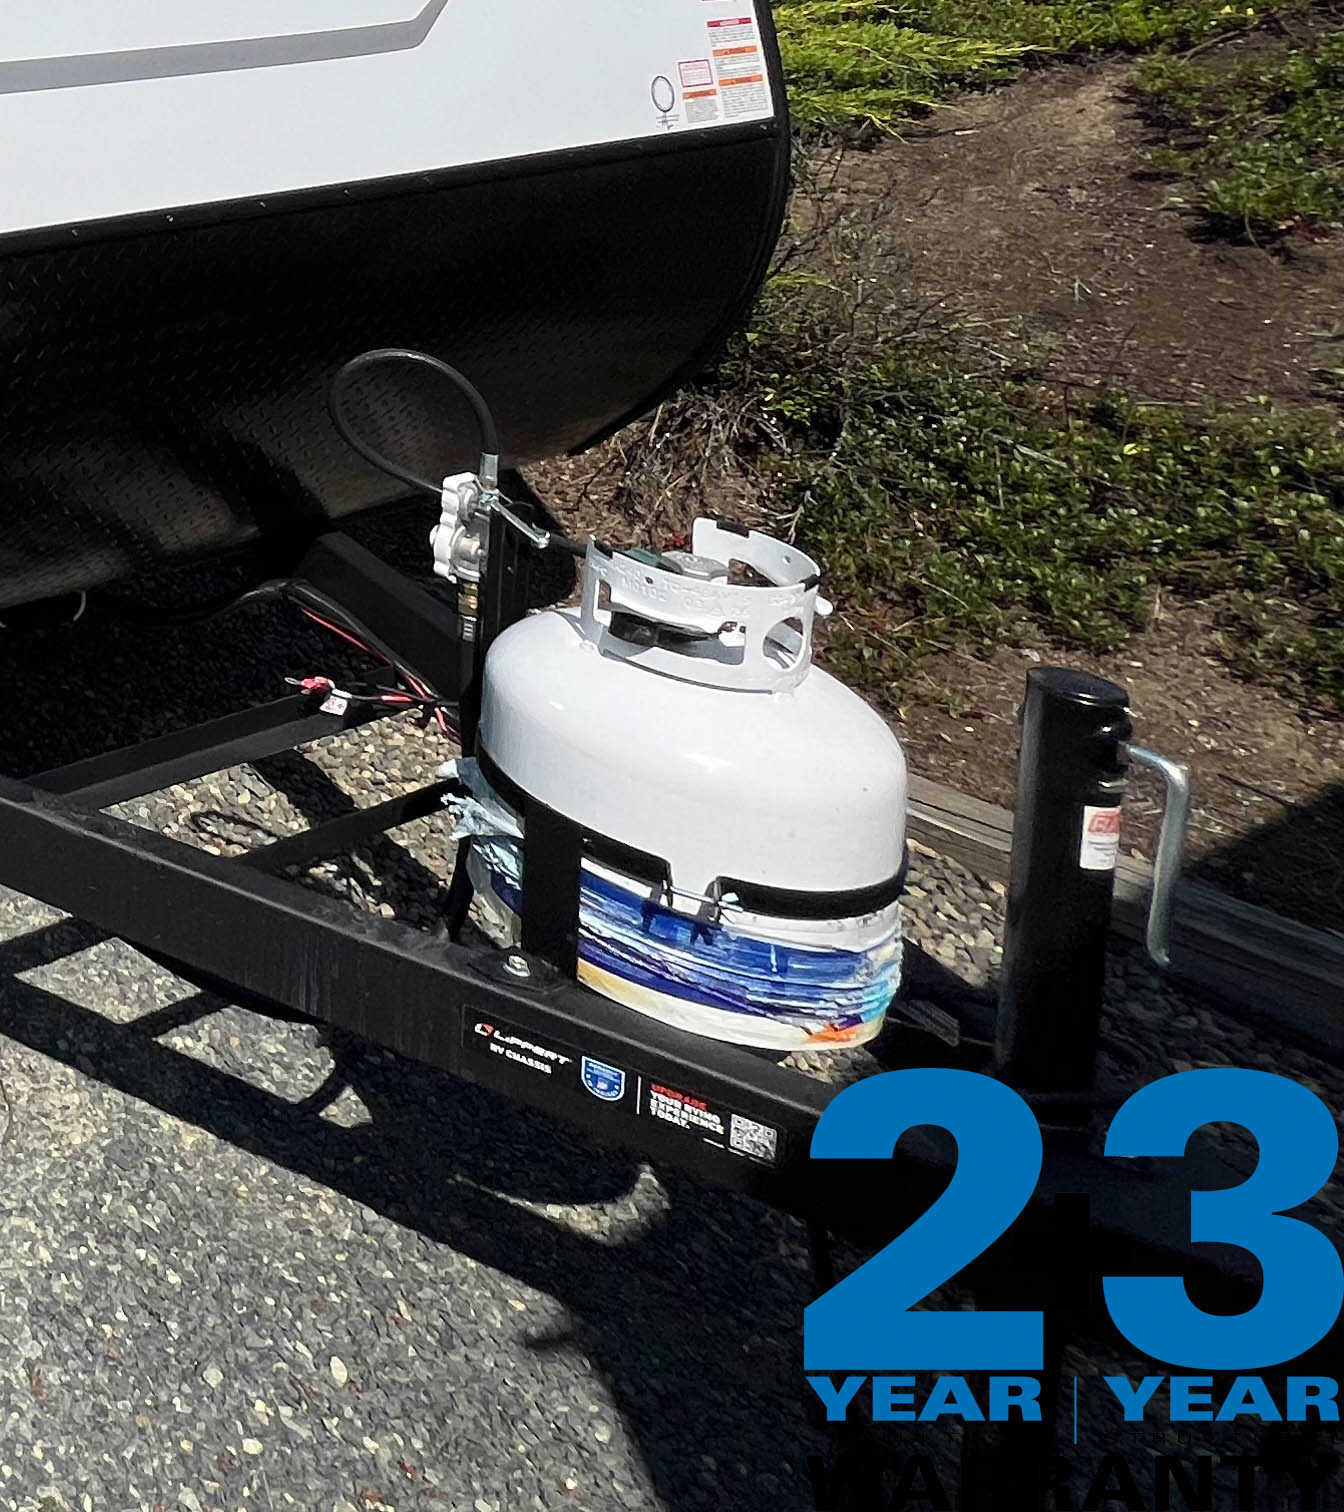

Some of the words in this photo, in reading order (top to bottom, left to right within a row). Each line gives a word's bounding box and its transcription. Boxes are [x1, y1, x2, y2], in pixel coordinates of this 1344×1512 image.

[489, 1042, 505, 1055] RV
[505, 1049, 552, 1075] CHASSIS
[493, 1030, 570, 1065] LIPPERT
[650, 1097, 725, 1135] EXPERIENCE
